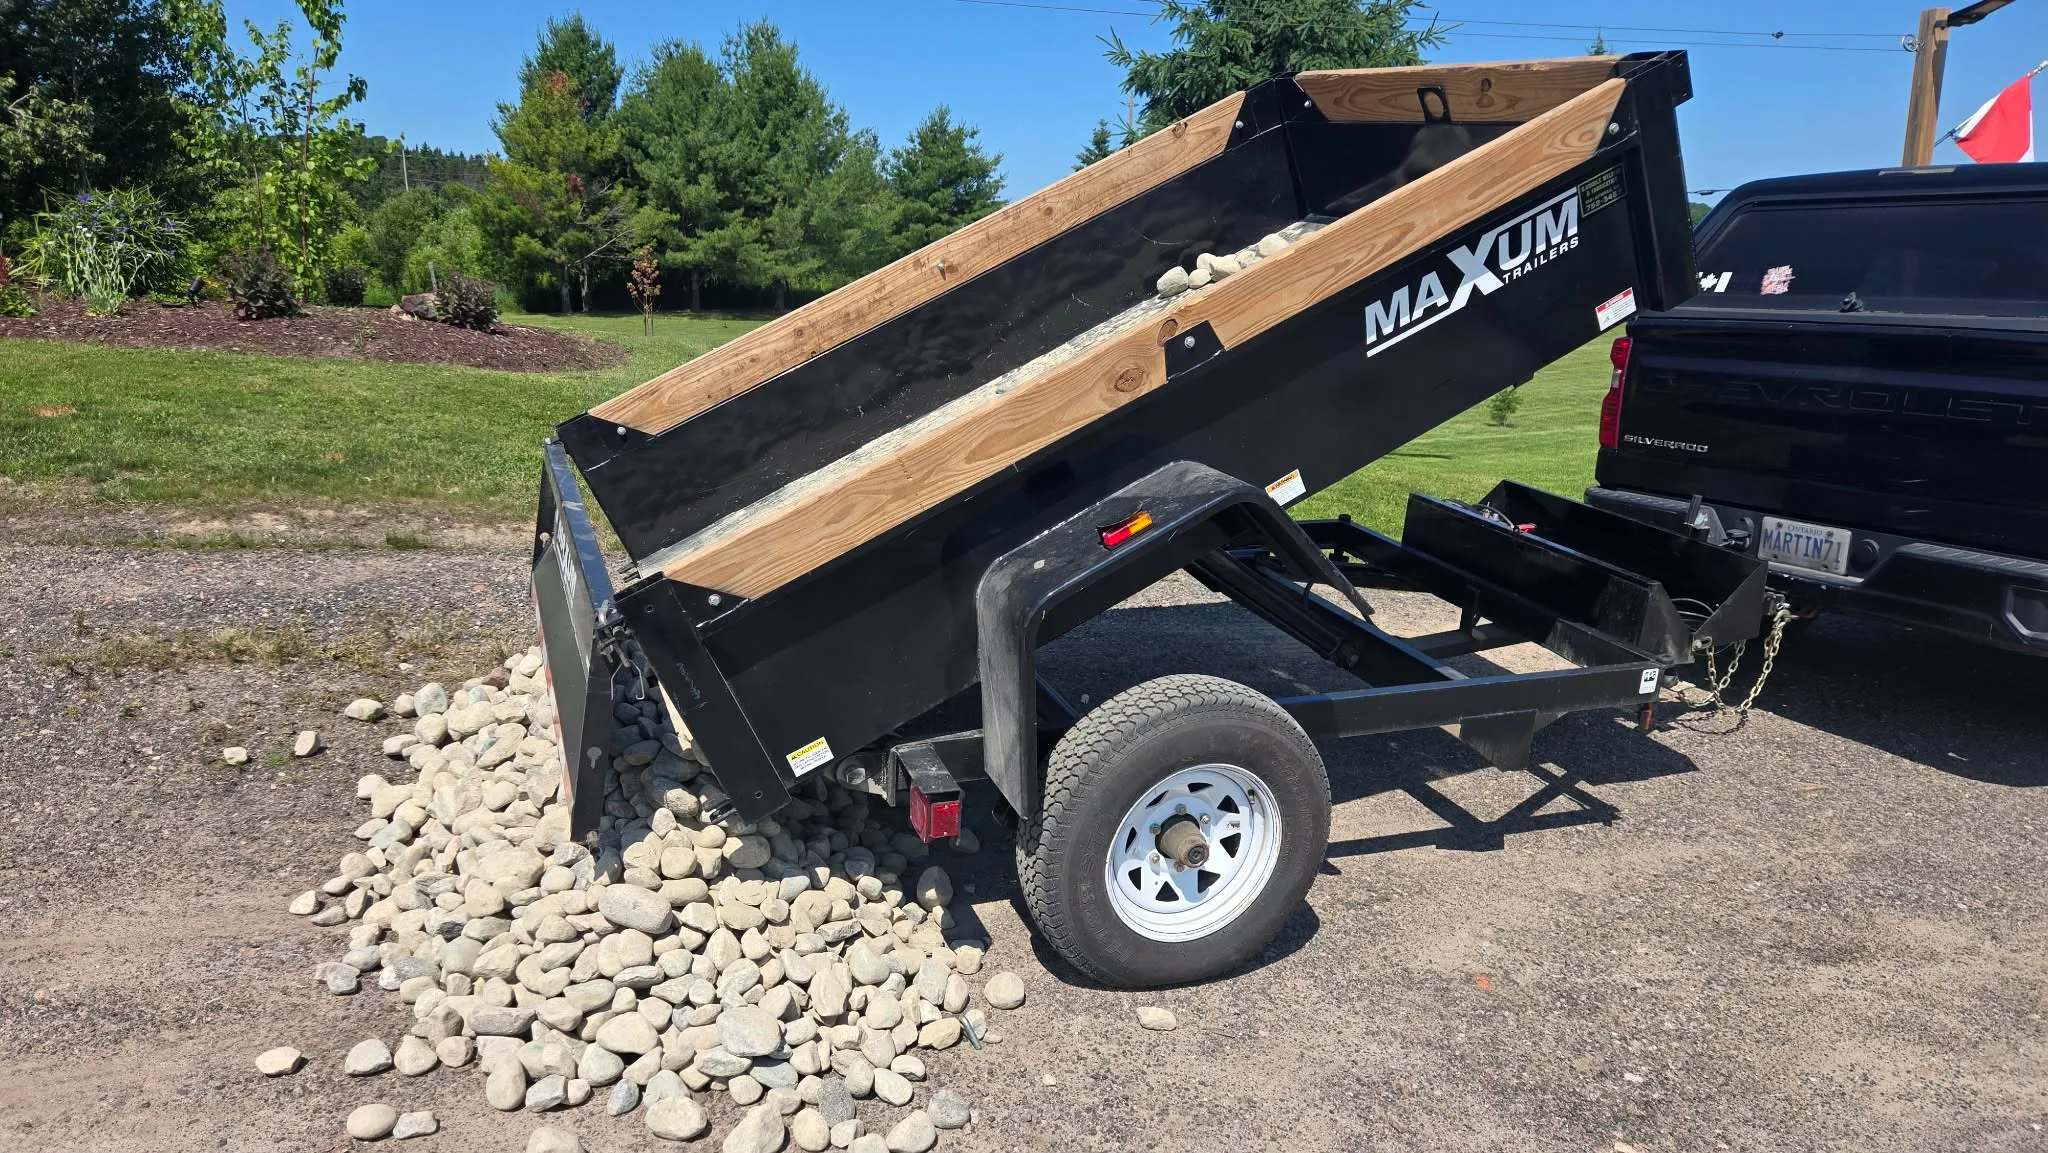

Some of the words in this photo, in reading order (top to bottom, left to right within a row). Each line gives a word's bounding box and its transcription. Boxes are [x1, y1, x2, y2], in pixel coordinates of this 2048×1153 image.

[1365, 194, 1578, 346] MAXUM
[1503, 236, 1579, 284] TRAILERS
[1624, 434, 1708, 453] SILVERADO
[1788, 524, 1823, 536] ONTARIO
[1762, 527, 1842, 564] MARTIN71
[797, 740, 824, 757] CAUTION
